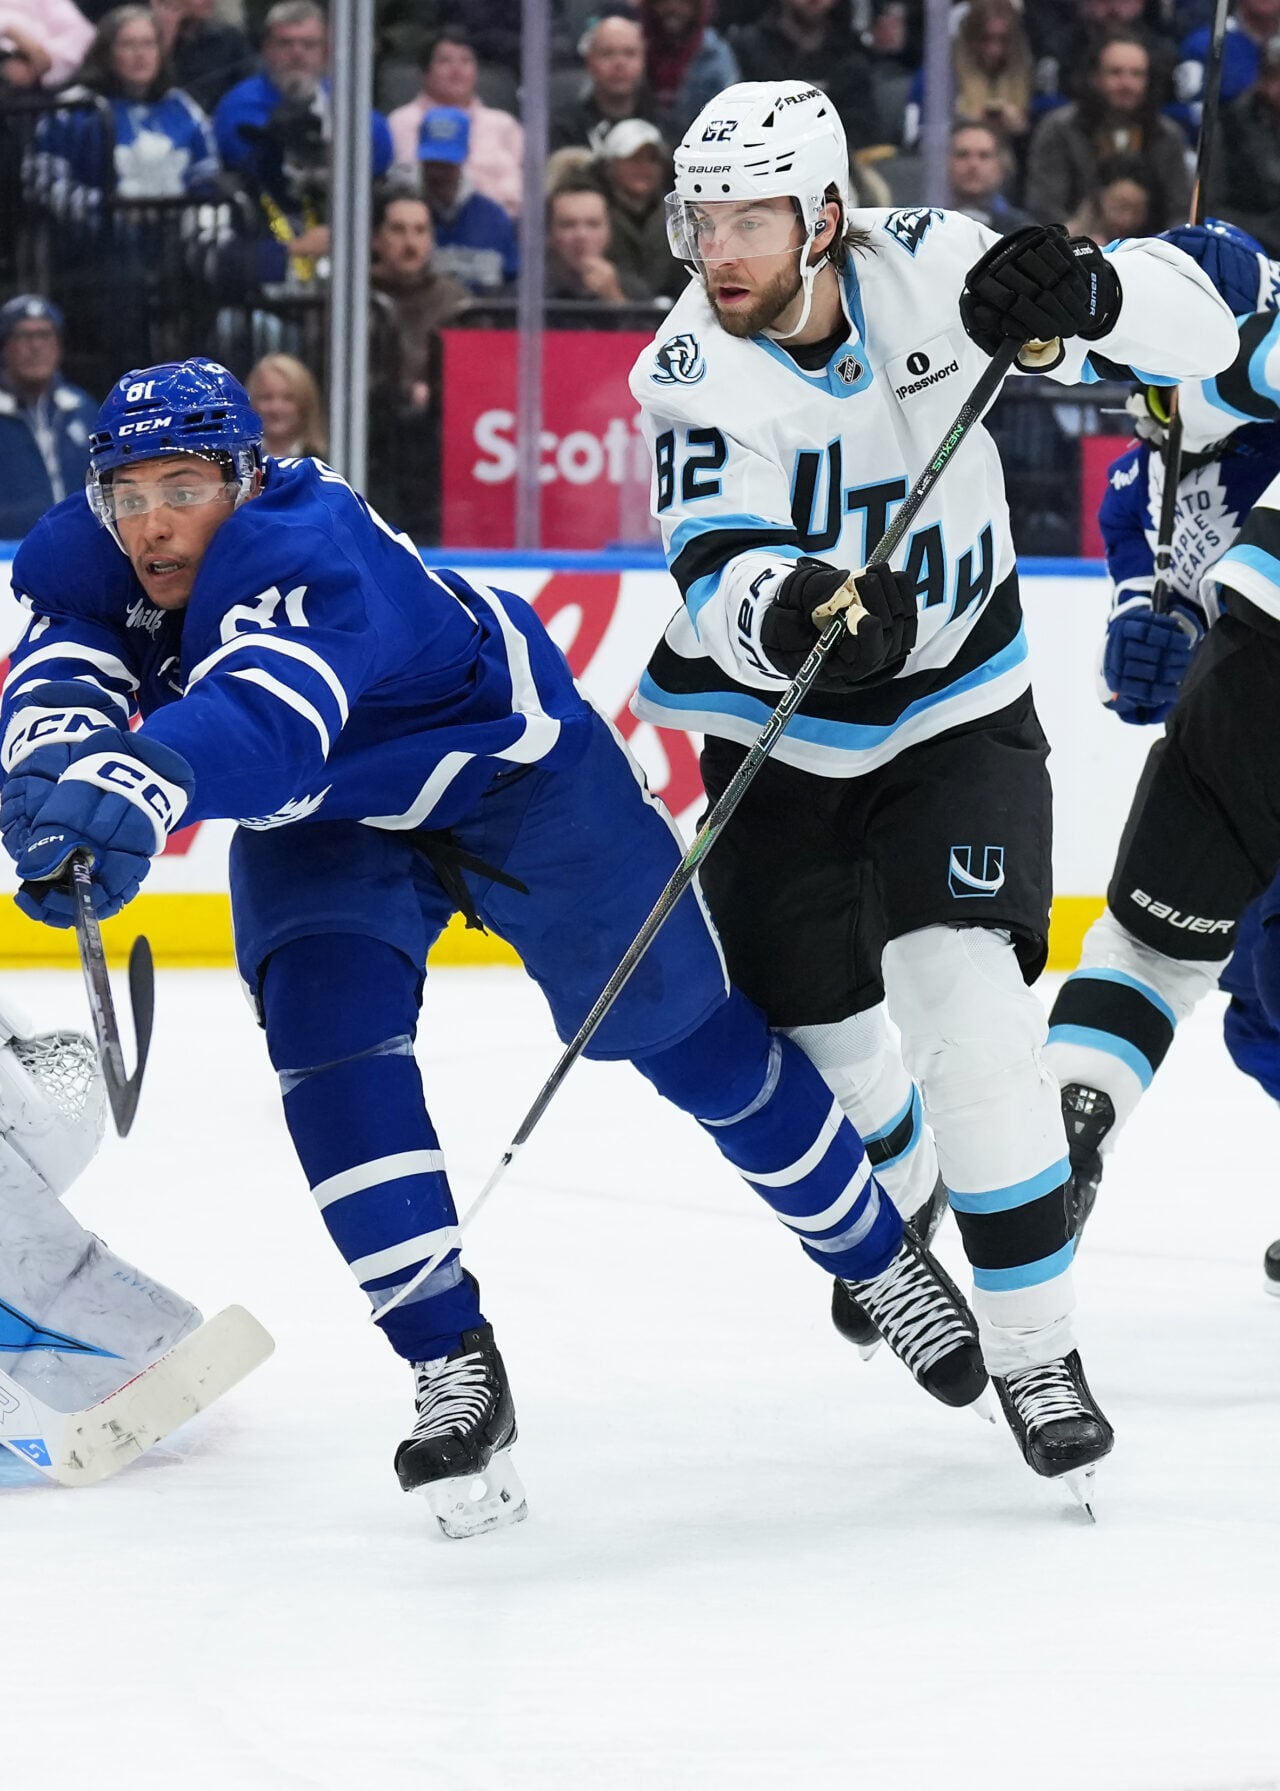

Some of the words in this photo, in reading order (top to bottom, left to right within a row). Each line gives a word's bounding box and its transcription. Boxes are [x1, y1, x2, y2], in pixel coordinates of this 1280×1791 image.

[687, 164, 731, 174] BAUER
[1089, 272, 1097, 317] BAUER
[125, 379, 156, 402] 81
[895, 360, 959, 400] 1Password
[118, 416, 172, 437] CCM
[931, 423, 965, 472] NEXUS
[654, 426, 729, 515] 82
[790, 434, 993, 627] UTAH
[1177, 530, 1221, 589] LEAFS
[125, 598, 167, 641] Milk
[220, 585, 310, 645] 81
[738, 567, 796, 681] UER
[9, 713, 115, 763] CCM
[96, 760, 173, 833] CC
[27, 834, 64, 853] CCM
[1130, 888, 1235, 934] BAUER
